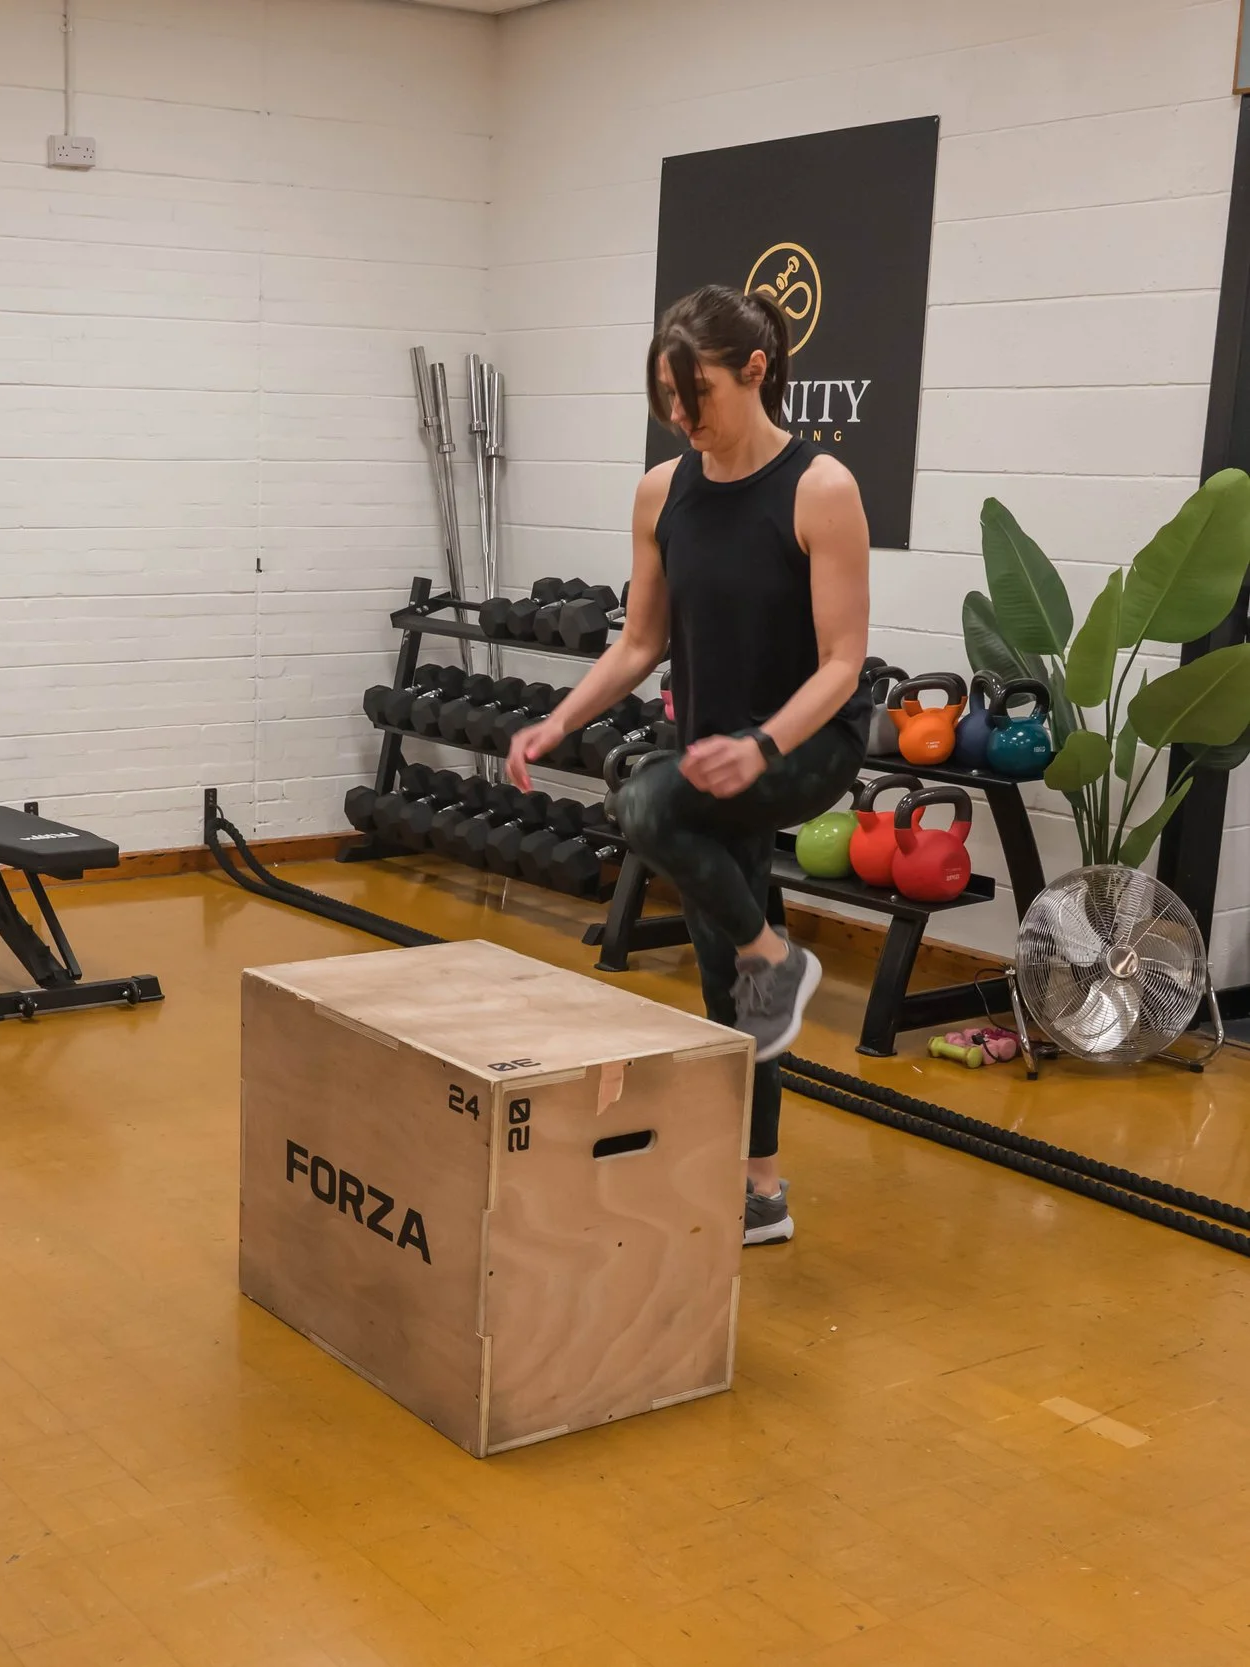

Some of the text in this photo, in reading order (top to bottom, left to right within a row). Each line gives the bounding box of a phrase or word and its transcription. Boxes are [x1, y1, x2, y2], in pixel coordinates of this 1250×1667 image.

[786, 428, 843, 442] ING
[448, 1083, 481, 1121] 24
[507, 1097, 531, 1153] 20
[286, 1138, 432, 1266] FORZA
